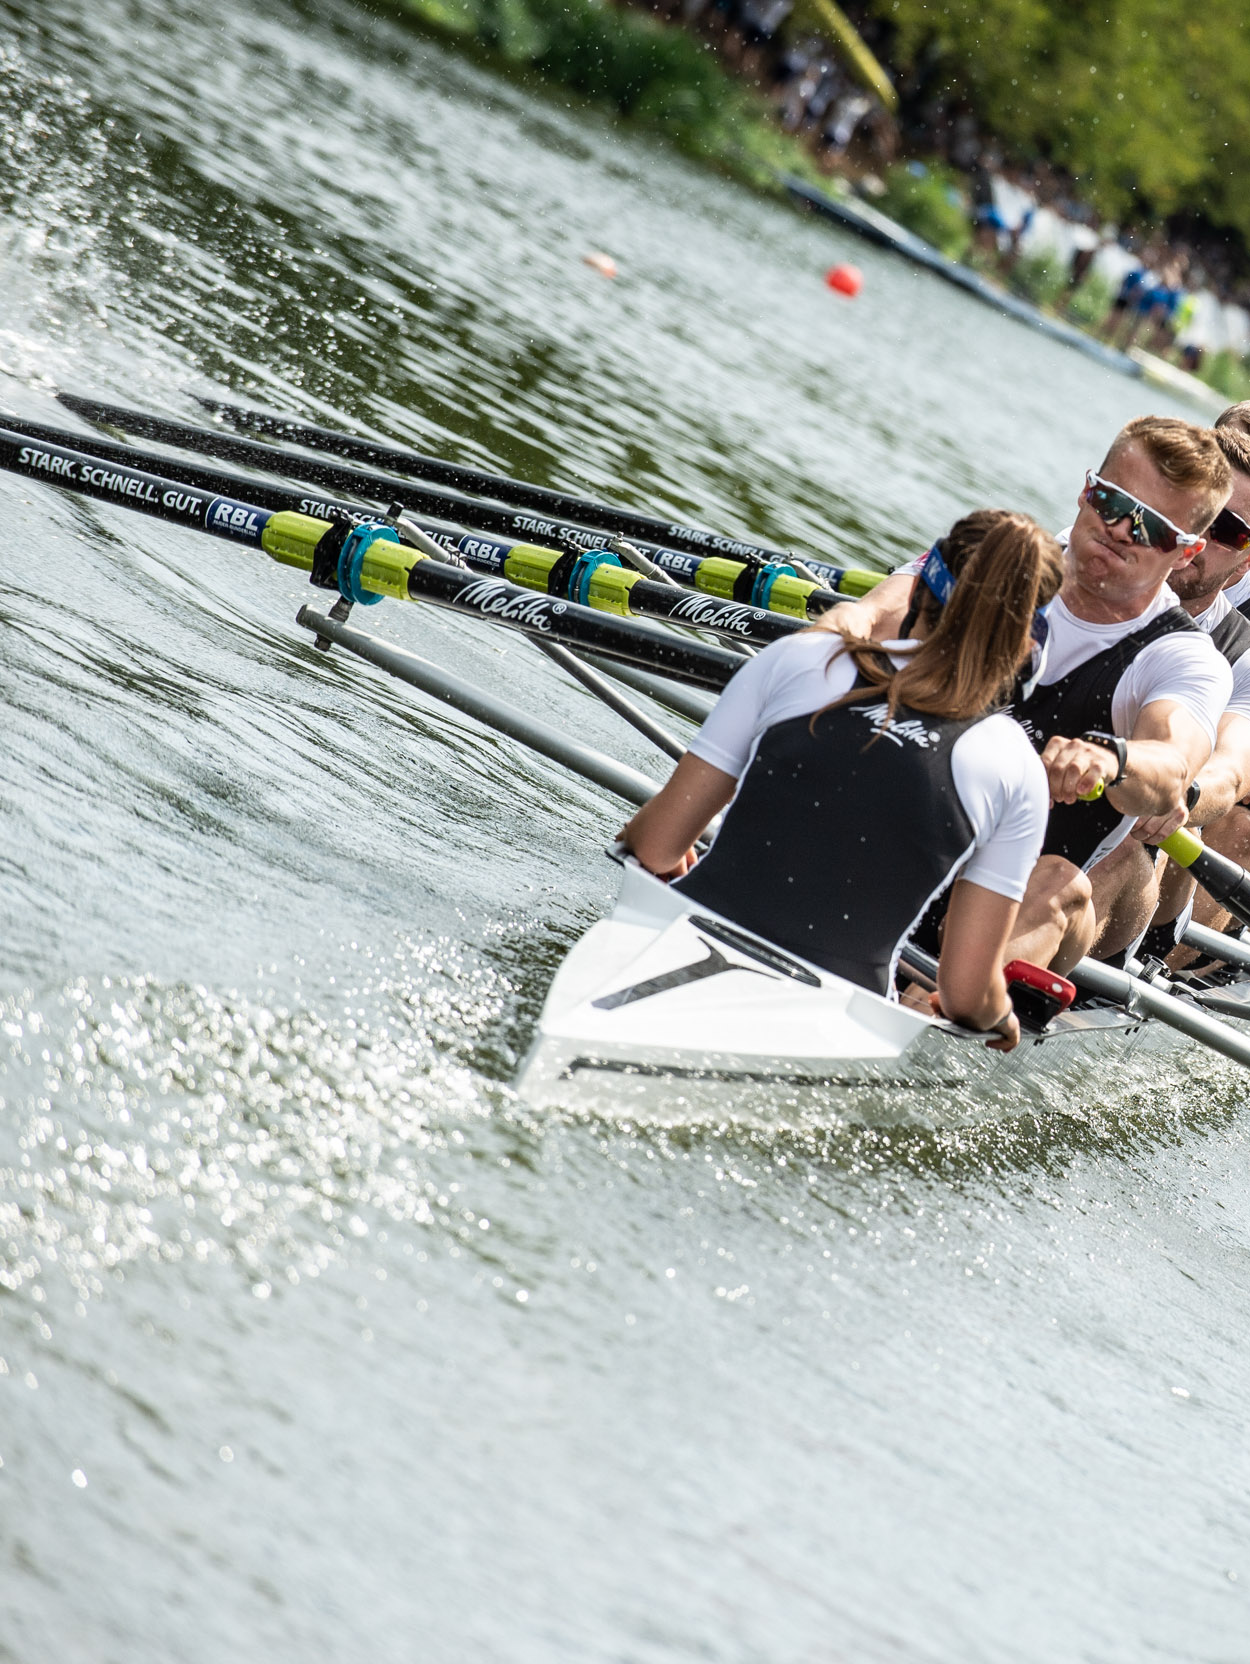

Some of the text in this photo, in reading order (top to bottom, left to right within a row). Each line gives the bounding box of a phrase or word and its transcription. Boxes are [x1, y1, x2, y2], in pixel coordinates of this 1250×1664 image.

[18, 447, 258, 531] STARK. SCHNELL. GUT. RBL
[512, 515, 556, 537] STARK.
[668, 525, 710, 547] STARK.
[464, 539, 501, 561] RBL
[659, 552, 693, 573] RBL
